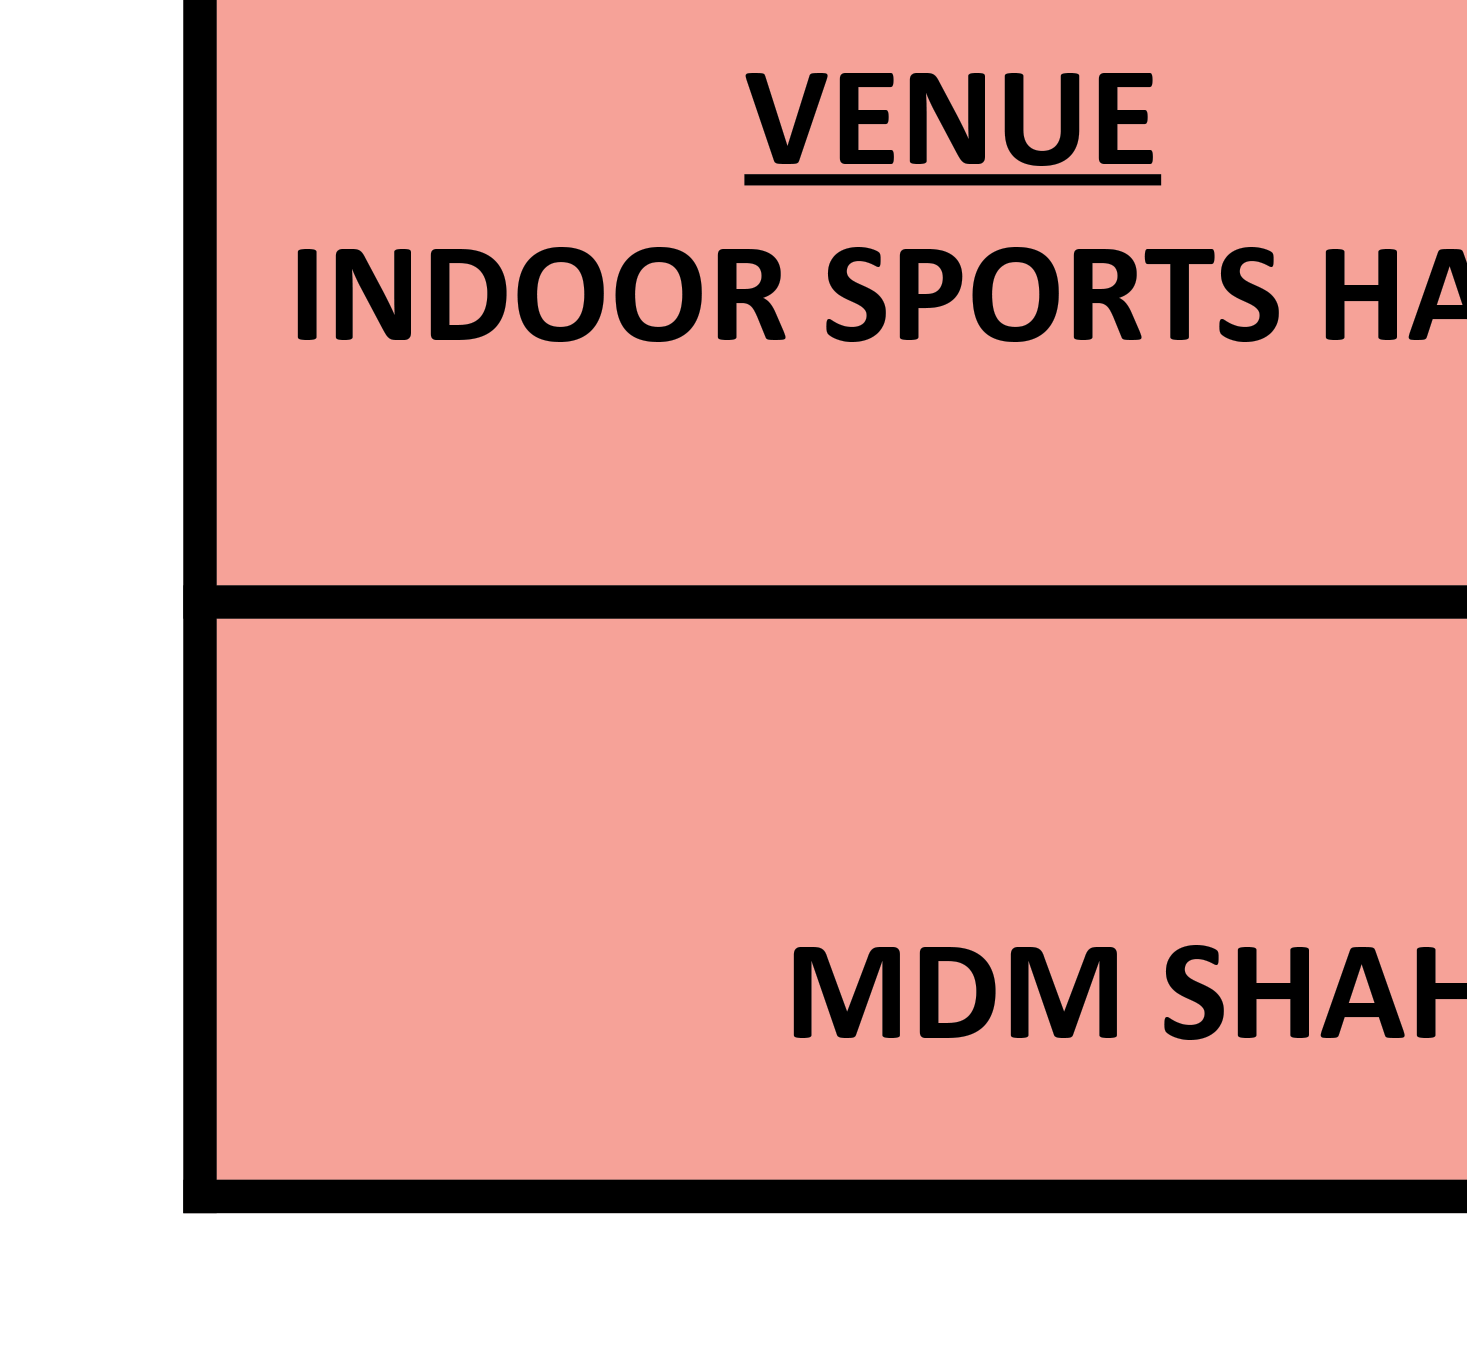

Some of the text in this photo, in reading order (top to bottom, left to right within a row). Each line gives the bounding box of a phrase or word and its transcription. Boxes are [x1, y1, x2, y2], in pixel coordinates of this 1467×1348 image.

[746, 73, 1153, 166] VENUE
[298, 247, 785, 342] INDOOR
[826, 247, 1279, 342] SPORTS
[794, 947, 1117, 1038] MDM
